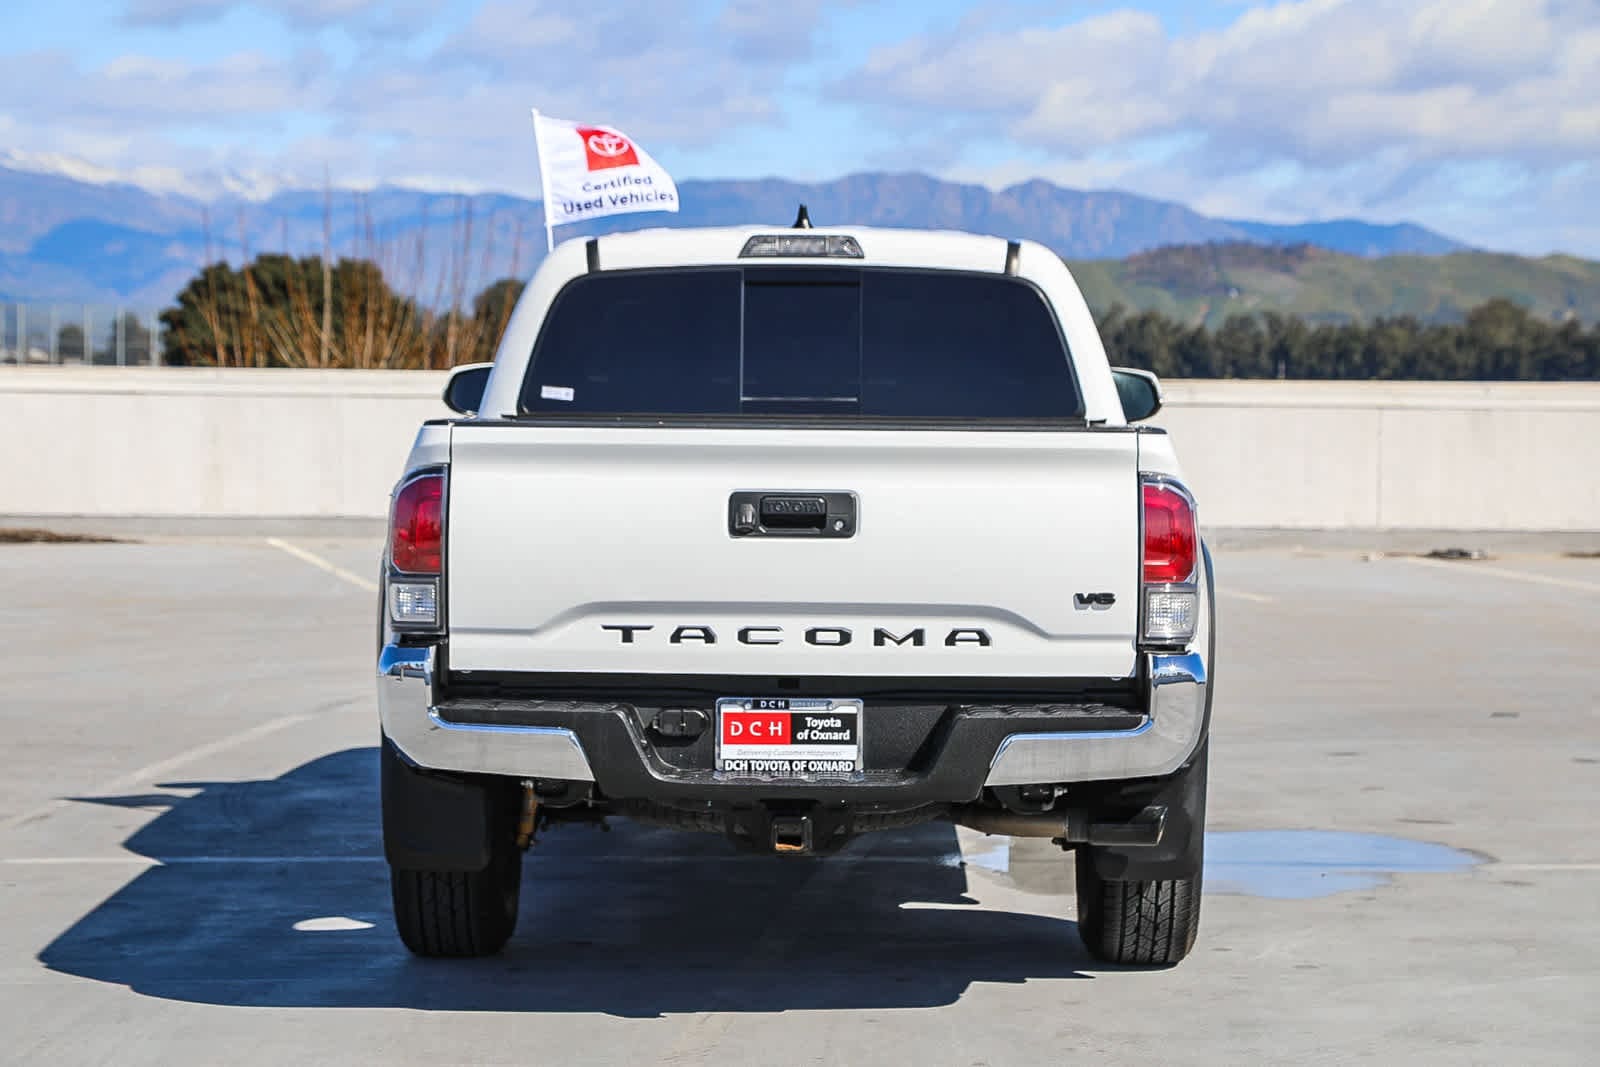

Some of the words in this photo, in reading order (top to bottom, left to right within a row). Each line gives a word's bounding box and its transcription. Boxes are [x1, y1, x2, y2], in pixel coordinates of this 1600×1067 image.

[582, 175, 653, 192] Certified
[563, 197, 603, 214] Used
[608, 191, 674, 207] Vehicles
[767, 501, 822, 512] TOYOTA
[1073, 593, 1116, 610] V6
[601, 624, 992, 647] TACOMA
[760, 700, 785, 708] DCH
[730, 721, 783, 737] DCH
[805, 717, 841, 730] Toyota
[796, 731, 810, 740] of
[810, 730, 850, 741] Oxnard
[724, 760, 748, 771] DCH
[749, 760, 790, 771] TOYOTA
[792, 760, 807, 771] OF
[808, 760, 854, 772] OXNARD
